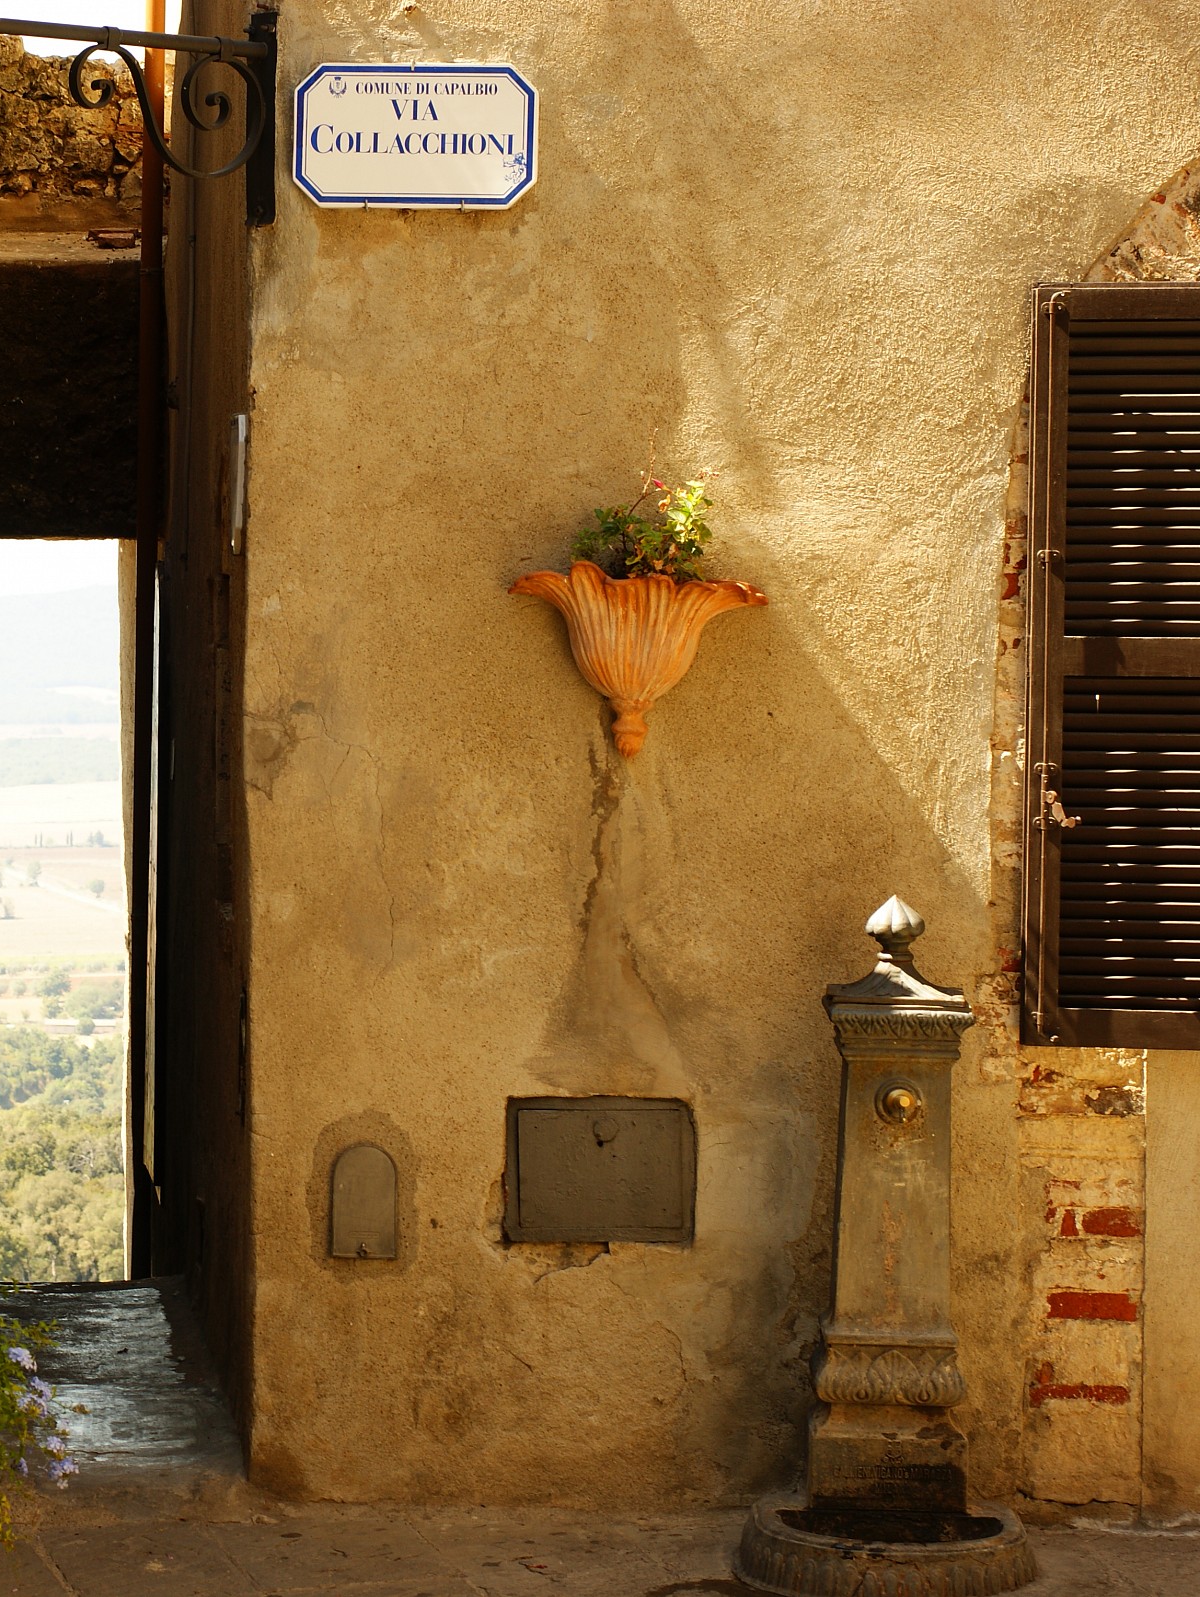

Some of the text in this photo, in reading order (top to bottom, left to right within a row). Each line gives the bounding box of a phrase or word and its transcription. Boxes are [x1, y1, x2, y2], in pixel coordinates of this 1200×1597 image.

[355, 82, 498, 96] COMUNE DI CAPALBIO
[389, 99, 439, 121] VIA
